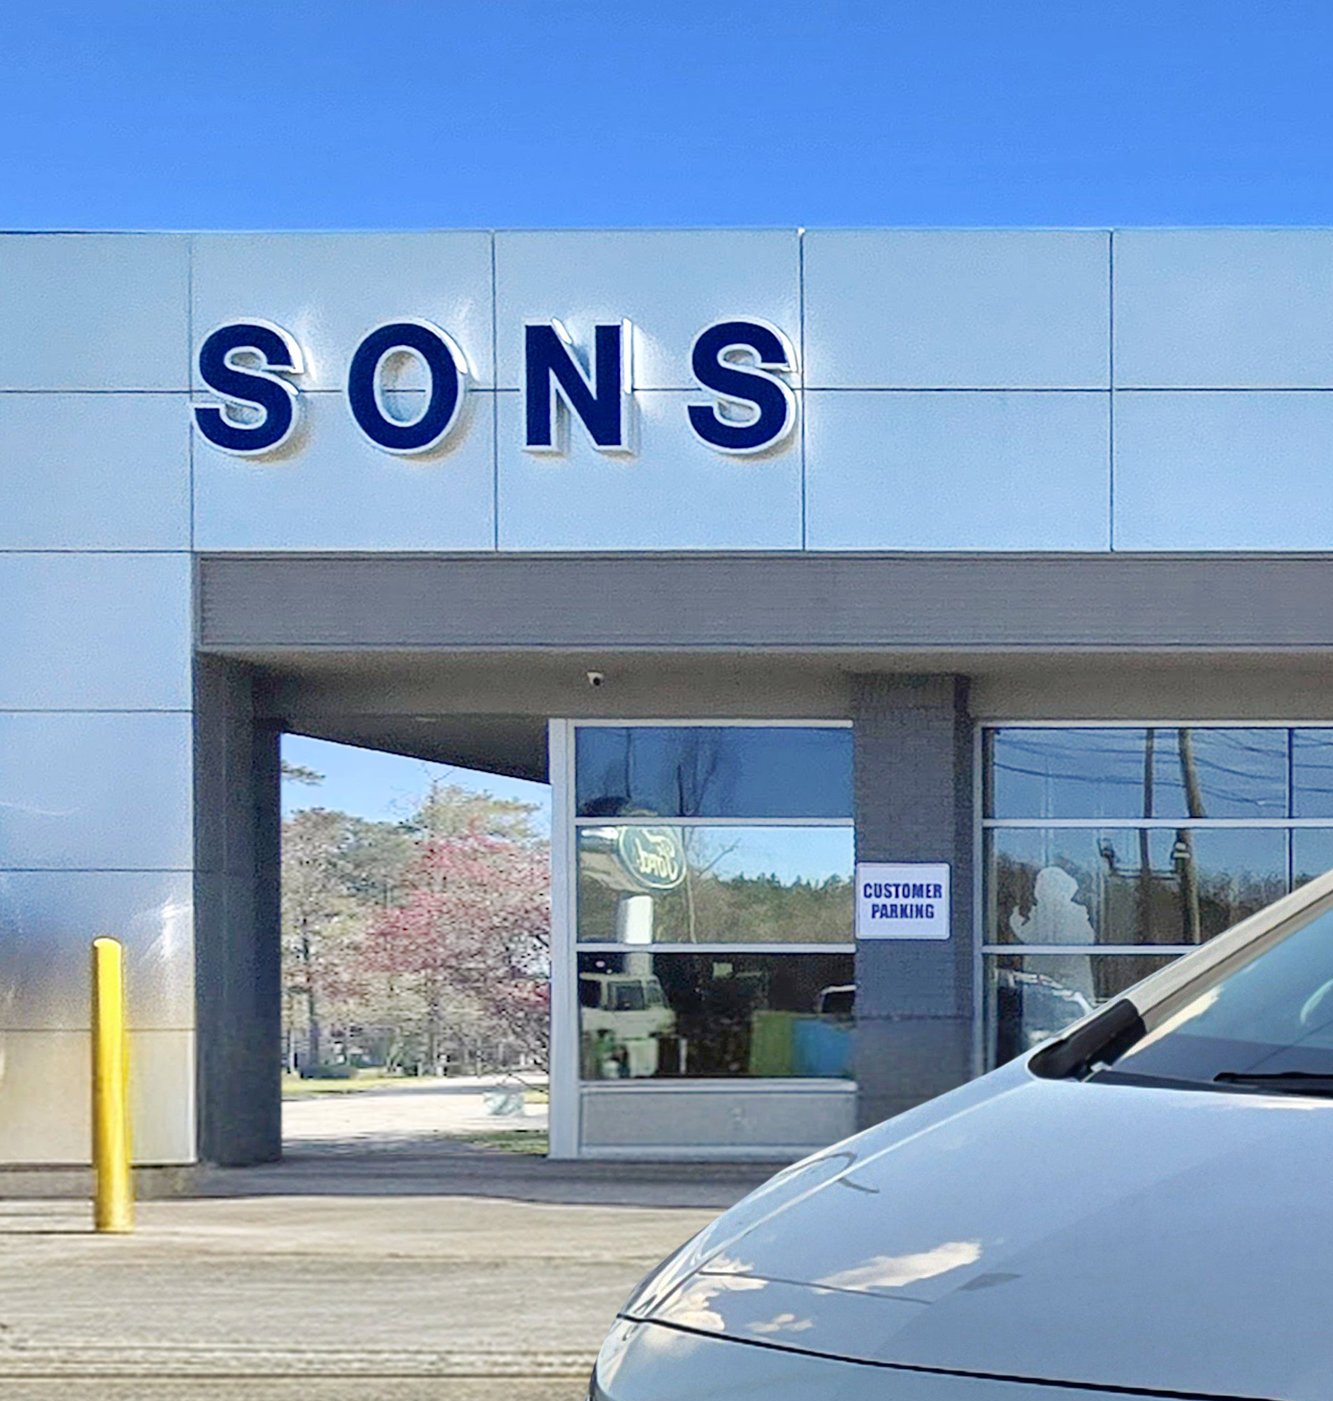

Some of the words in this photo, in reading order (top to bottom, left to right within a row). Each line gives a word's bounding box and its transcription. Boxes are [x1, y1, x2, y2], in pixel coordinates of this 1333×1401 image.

[194, 320, 790, 454] SONS
[863, 883, 942, 899] CUSTOMER
[871, 903, 935, 919] PARKING
